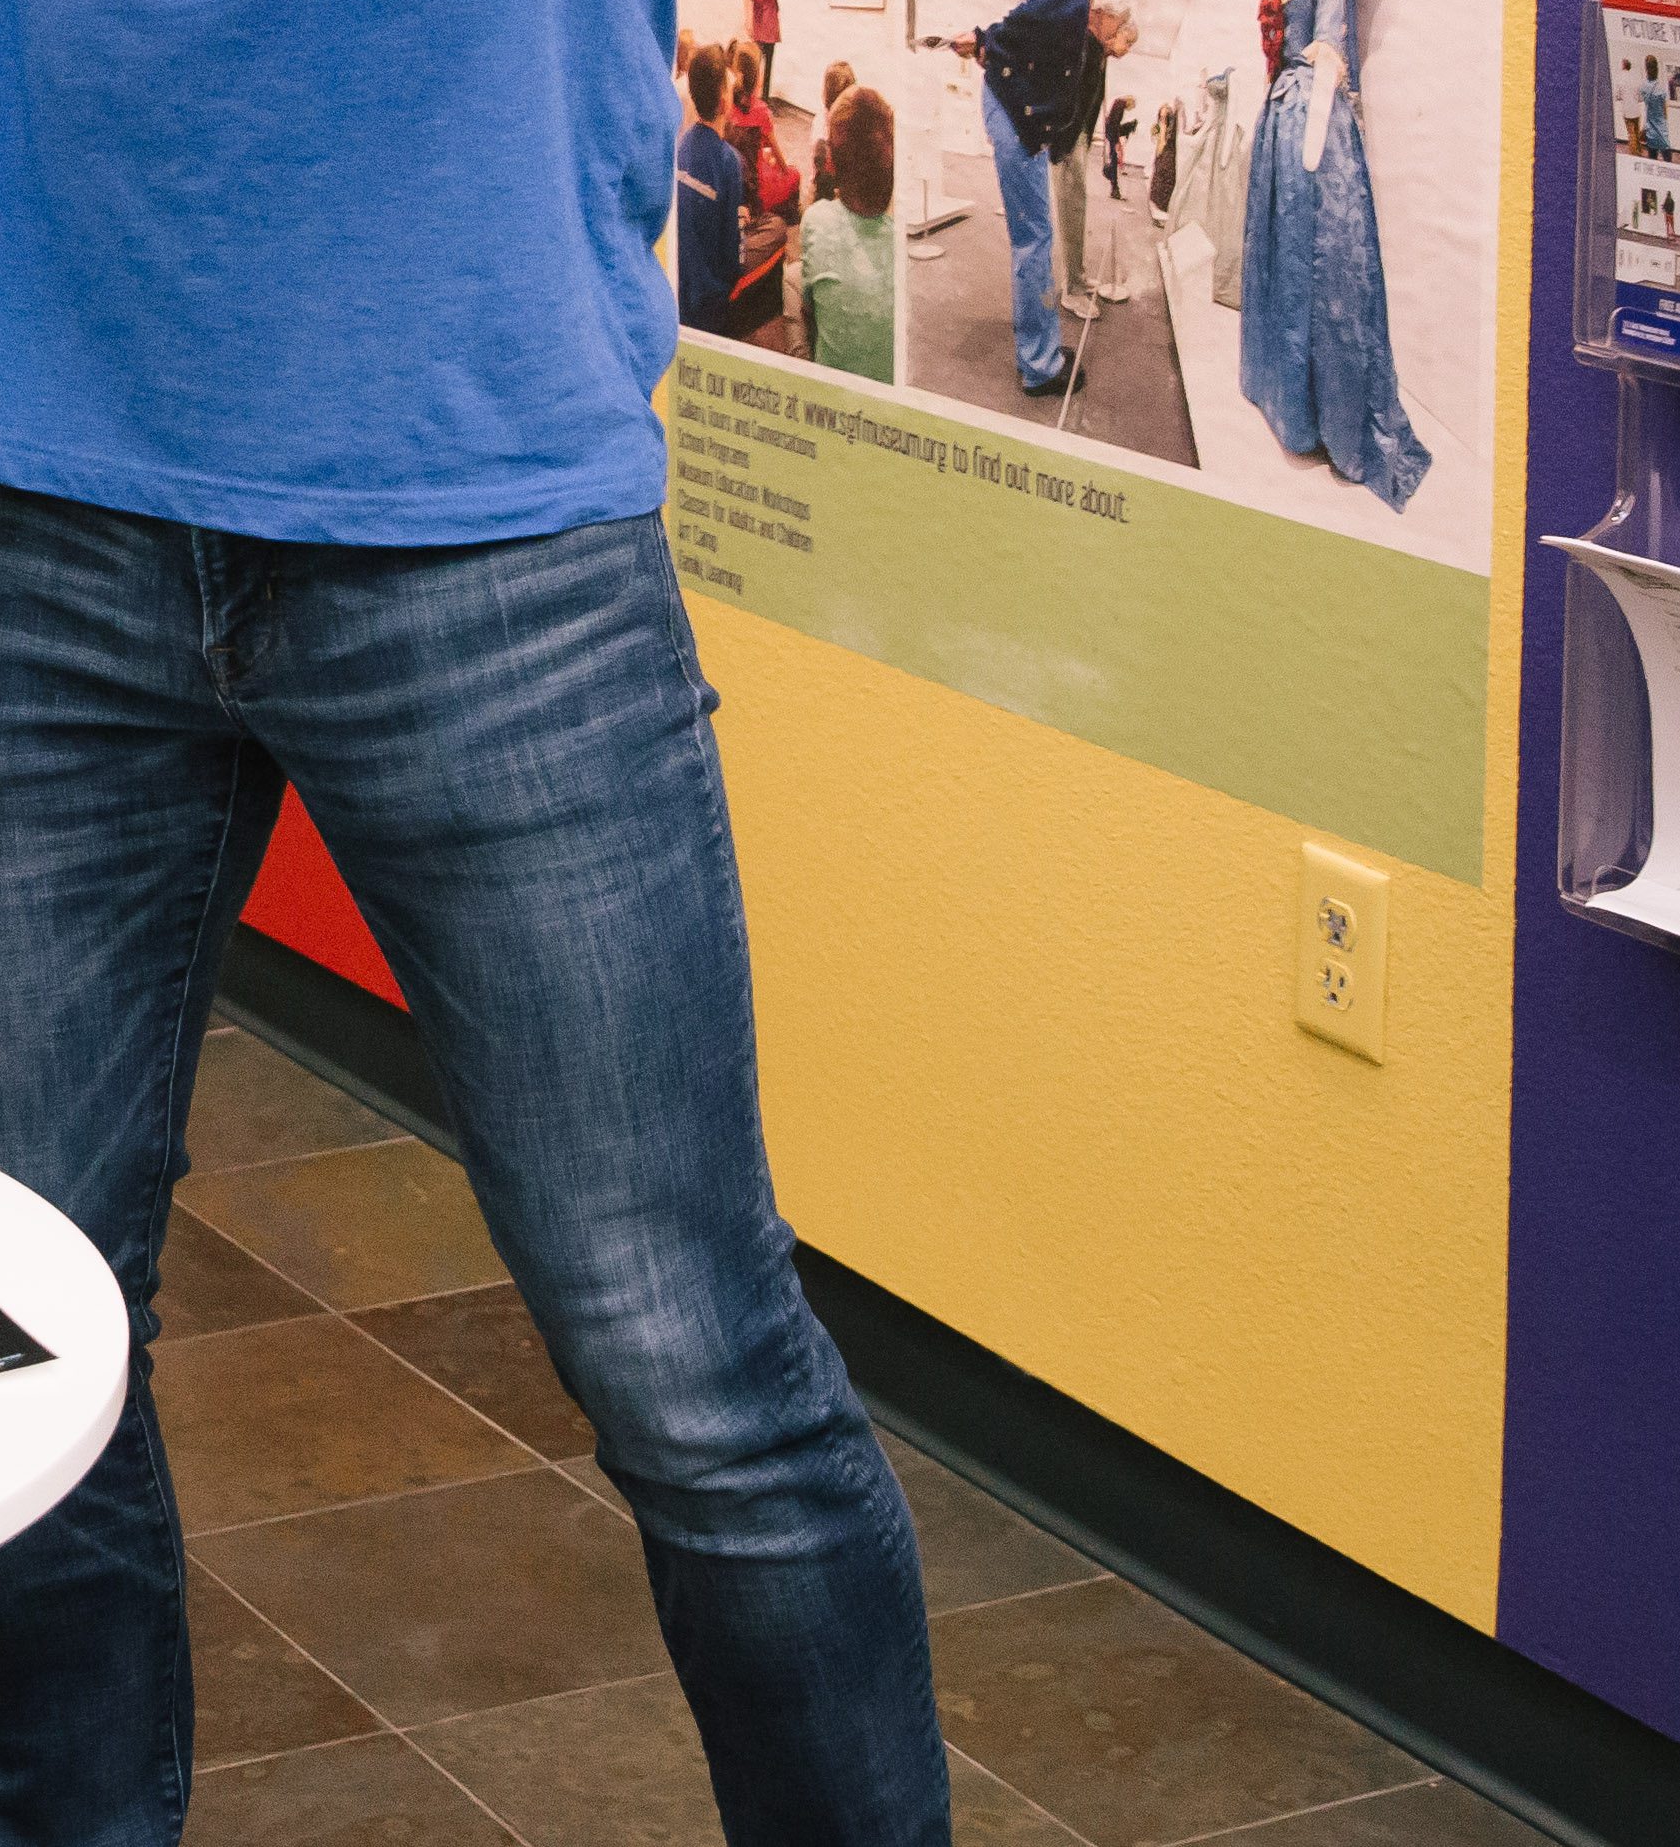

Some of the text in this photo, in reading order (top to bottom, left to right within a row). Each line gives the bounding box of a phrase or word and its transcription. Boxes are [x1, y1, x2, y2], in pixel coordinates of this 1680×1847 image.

[705, 372, 727, 399] our
[730, 378, 781, 416] website
[784, 393, 800, 423] at
[803, 400, 947, 474] www.sgfmuseum.org
[952, 440, 969, 474] to
[972, 444, 1001, 484] find
[1005, 461, 1031, 494] out
[1035, 471, 1076, 507] more
